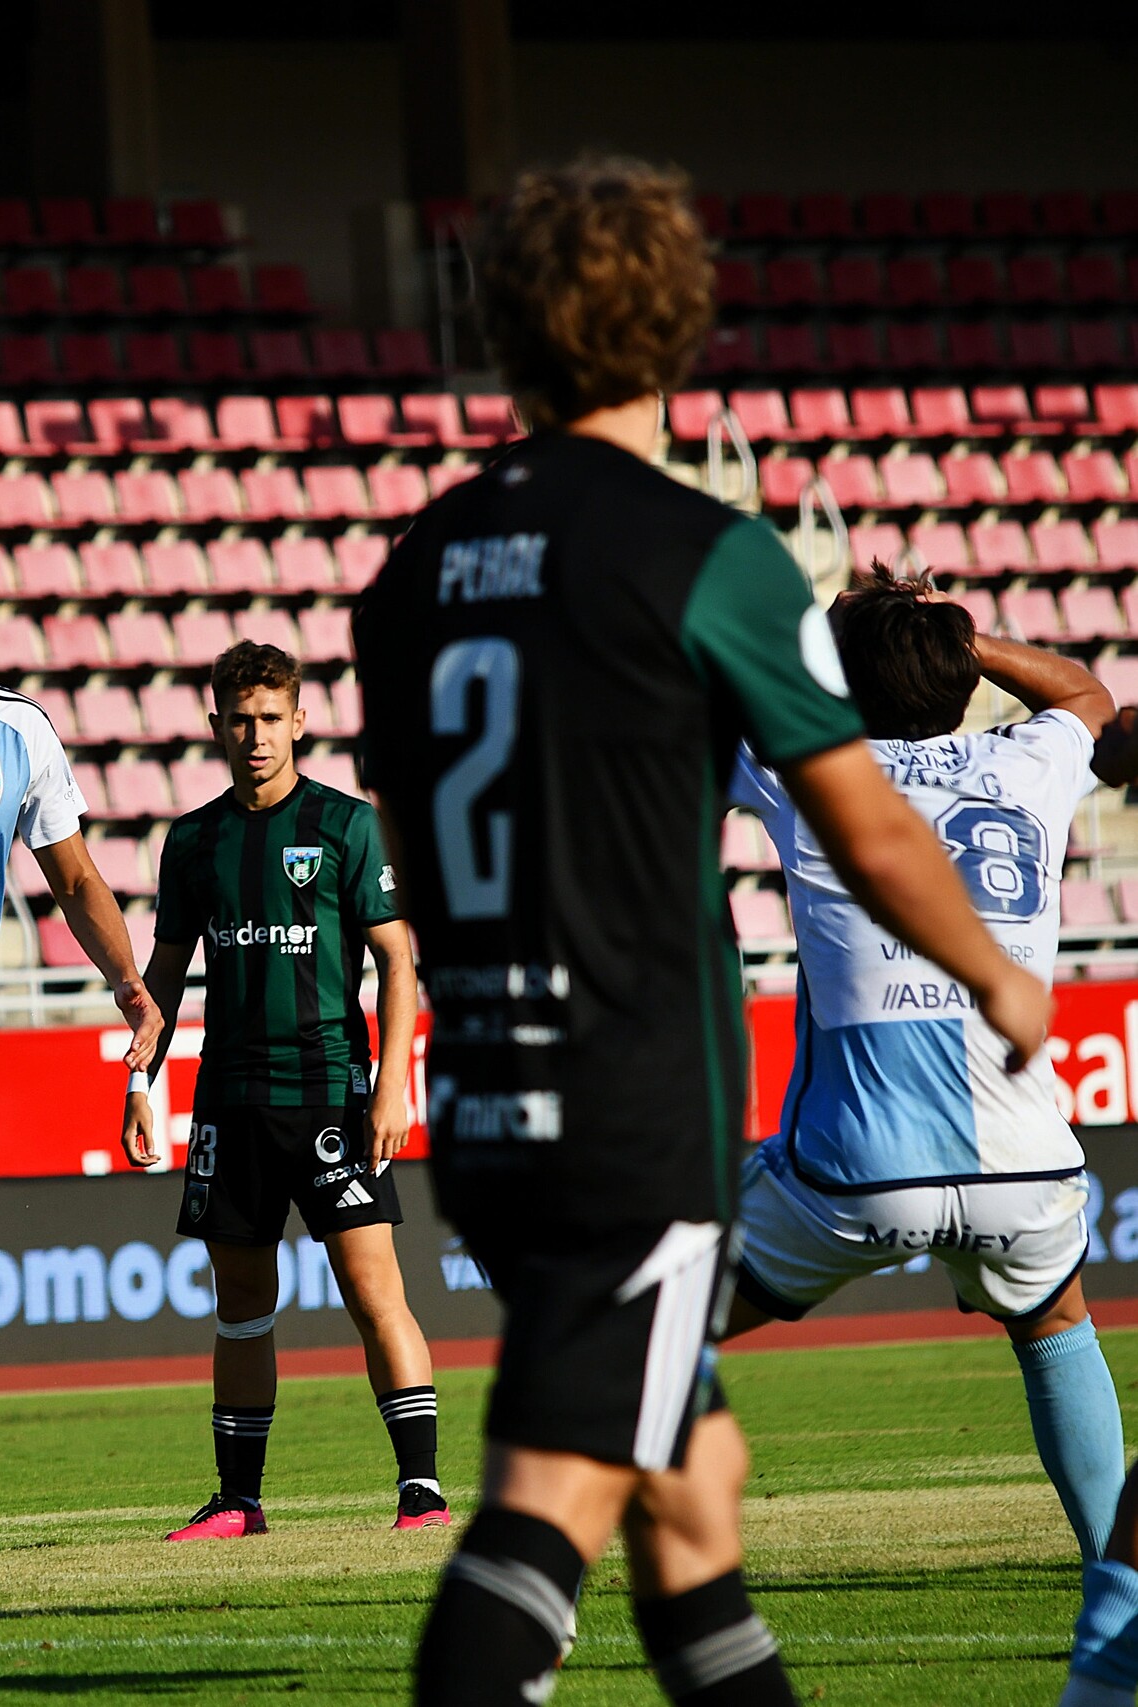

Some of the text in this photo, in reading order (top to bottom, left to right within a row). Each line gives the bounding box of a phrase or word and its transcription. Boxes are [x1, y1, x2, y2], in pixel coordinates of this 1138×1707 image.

[430, 635, 522, 920] 2
[218, 920, 318, 947] sidenor
[280, 944, 312, 954] steel
[188, 1122, 217, 1176] 23
[313, 1161, 368, 1187] GESCRAP
